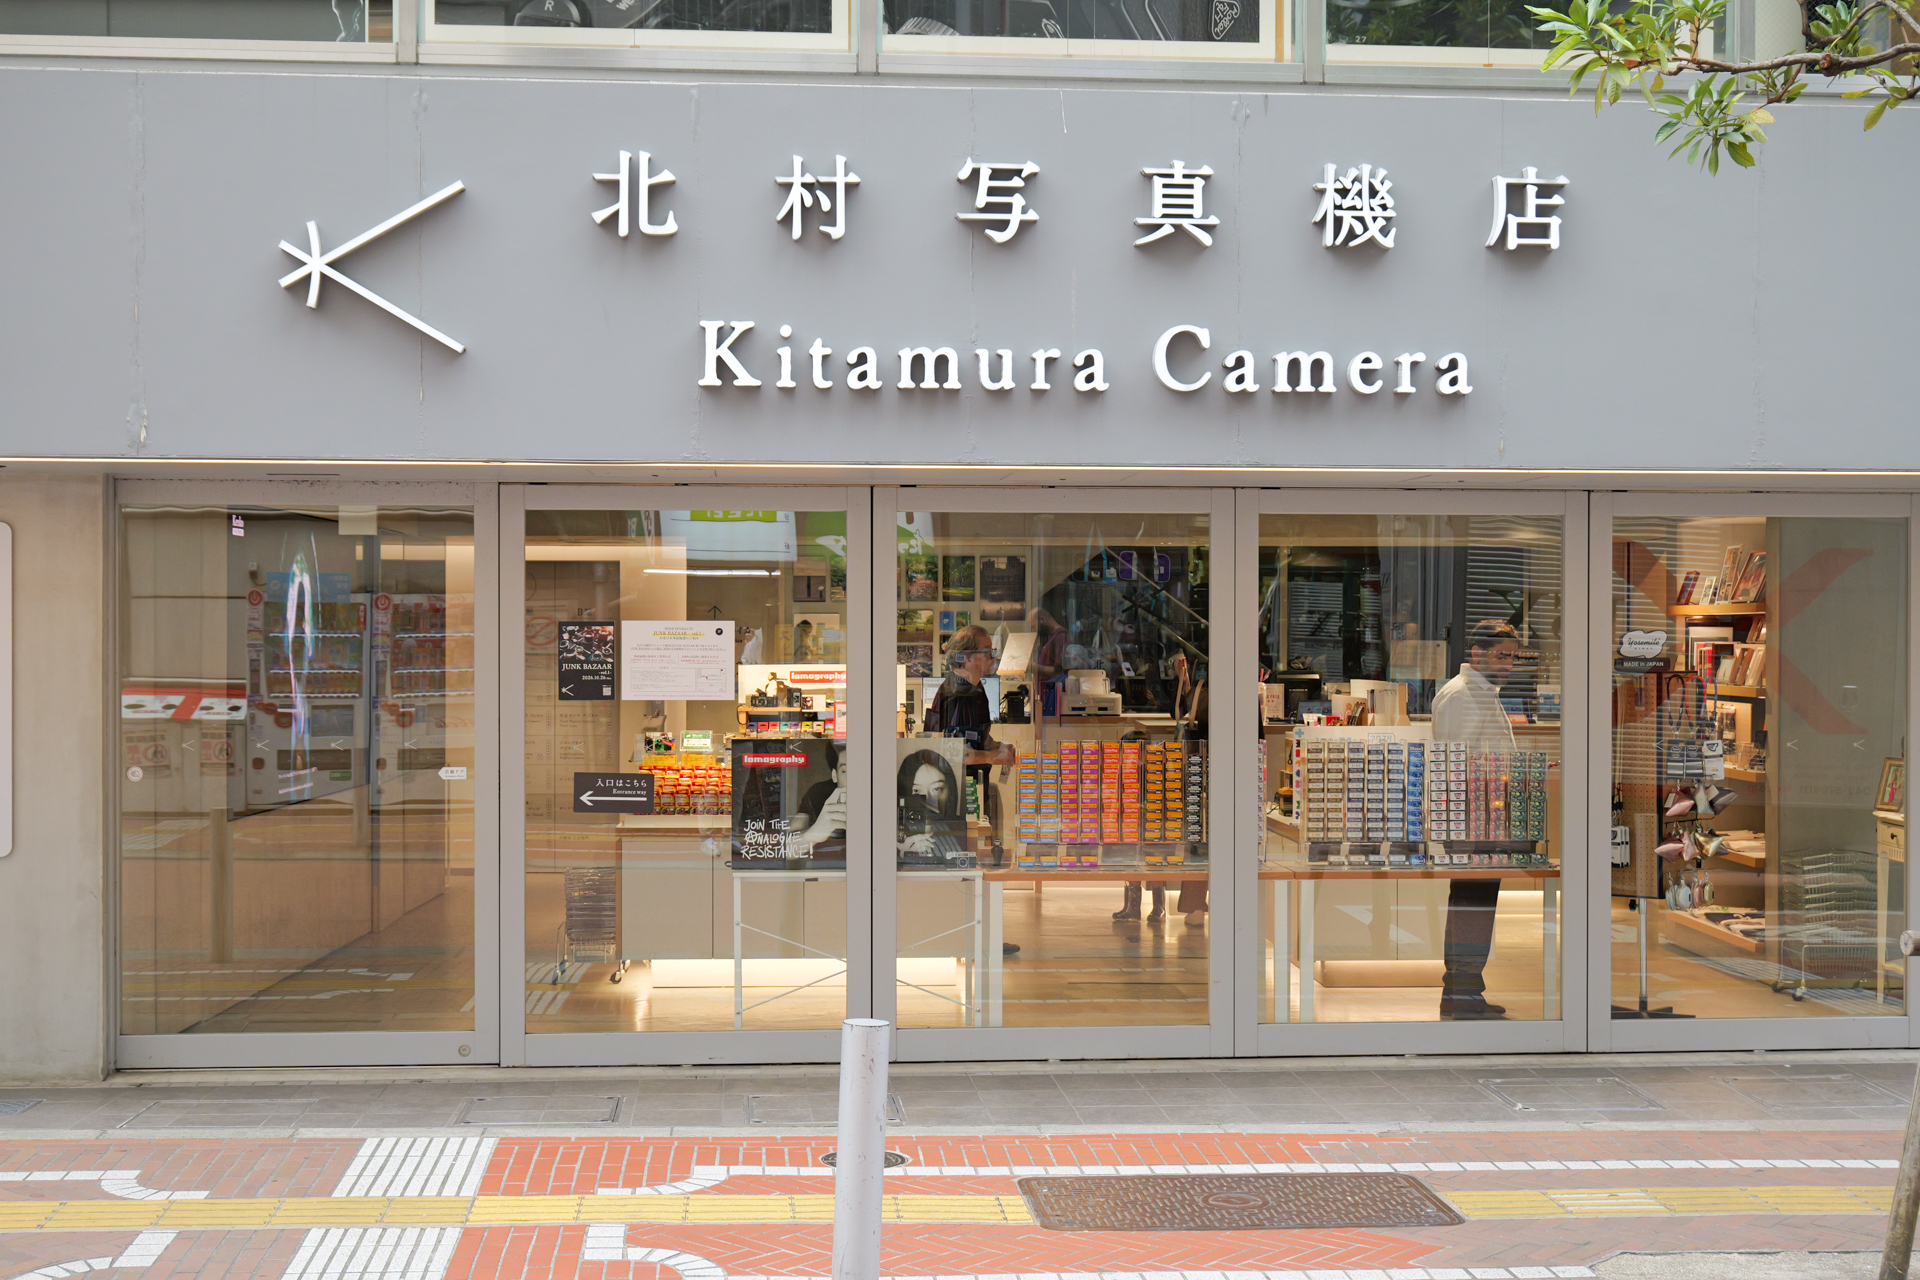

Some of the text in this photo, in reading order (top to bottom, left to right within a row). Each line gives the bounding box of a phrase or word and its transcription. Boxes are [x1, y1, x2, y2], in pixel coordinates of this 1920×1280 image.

[591, 150, 1570, 252] 北村写真機店
[698, 319, 1474, 396] Kitamura Camera
[1628, 637, 1660, 648] Yosemite
[791, 672, 846, 681] lomography
[744, 755, 805, 764] lomography
[595, 778, 647, 788] 入口はこちら
[769, 818, 790, 830] THE
